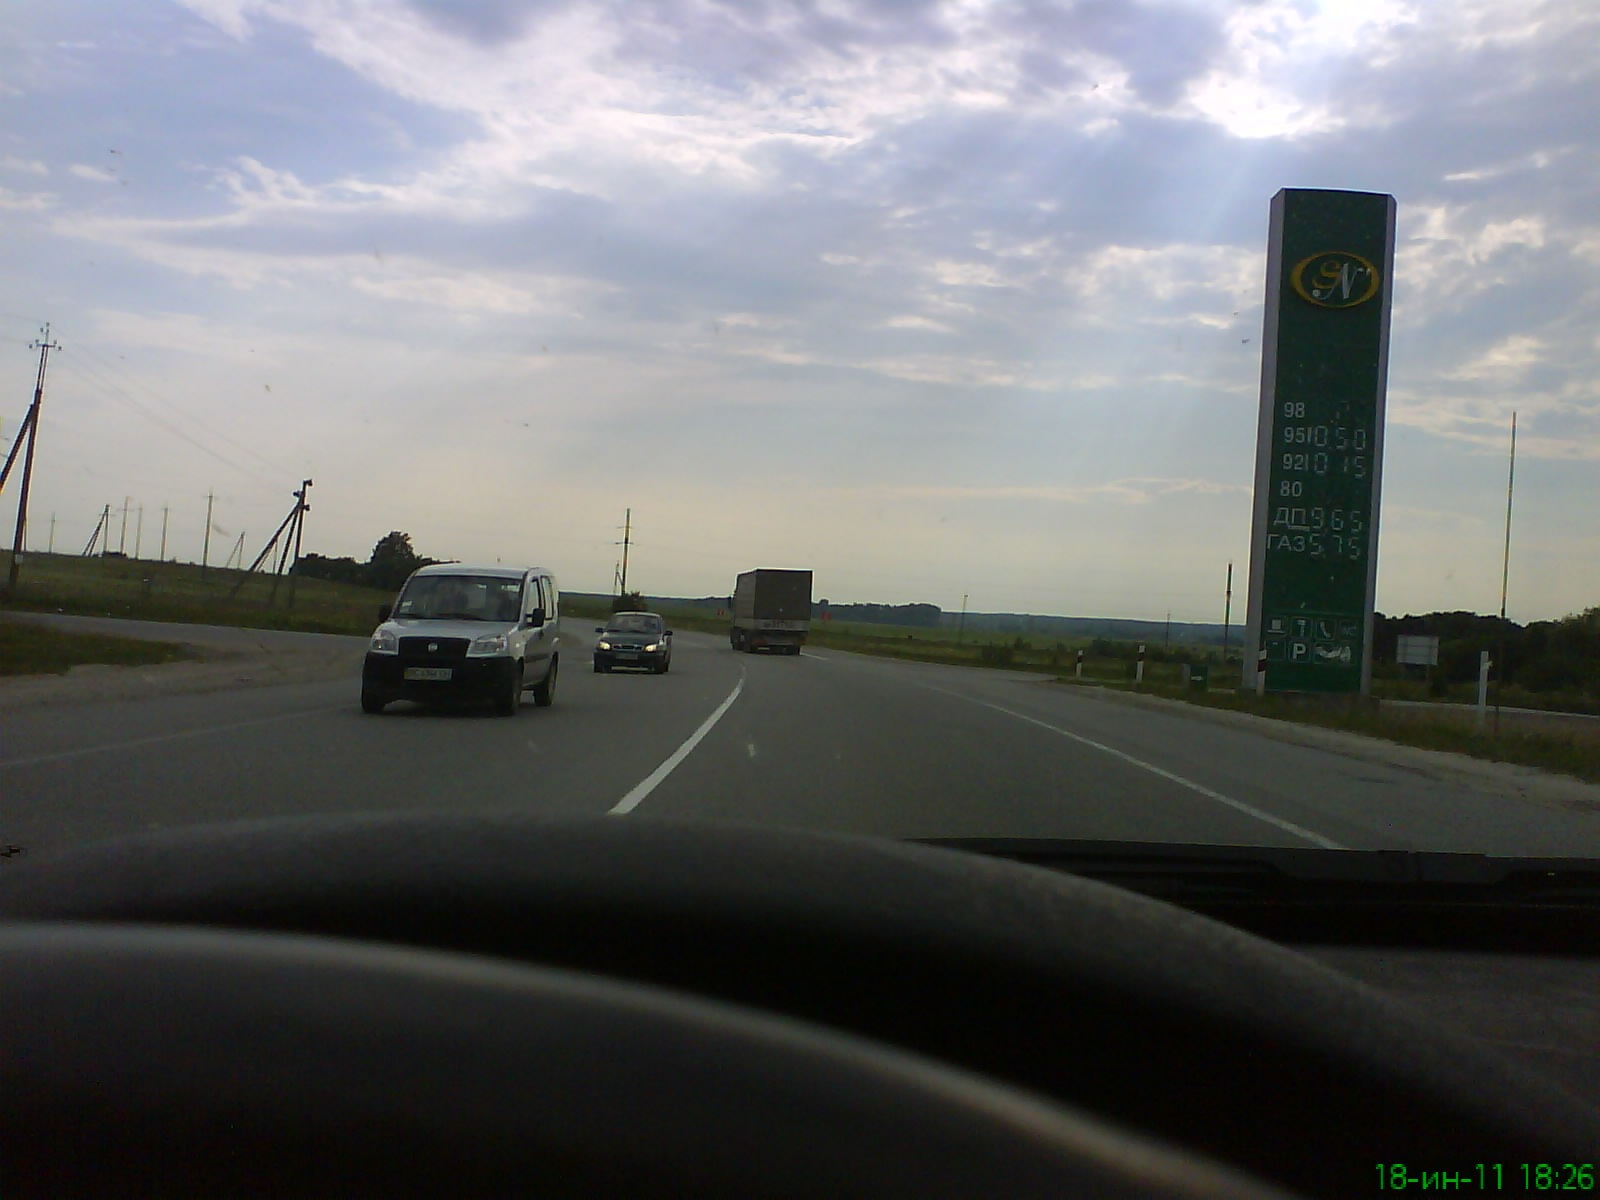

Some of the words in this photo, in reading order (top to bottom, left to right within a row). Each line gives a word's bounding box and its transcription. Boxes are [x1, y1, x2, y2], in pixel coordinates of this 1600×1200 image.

[1284, 401, 1305, 418] 98
[1284, 426, 1305, 443] 95
[1283, 453, 1304, 470] 92
[1280, 480, 1302, 497] 80
[1267, 533, 1305, 552] ГАЗ
[1292, 643, 1306, 660] P
